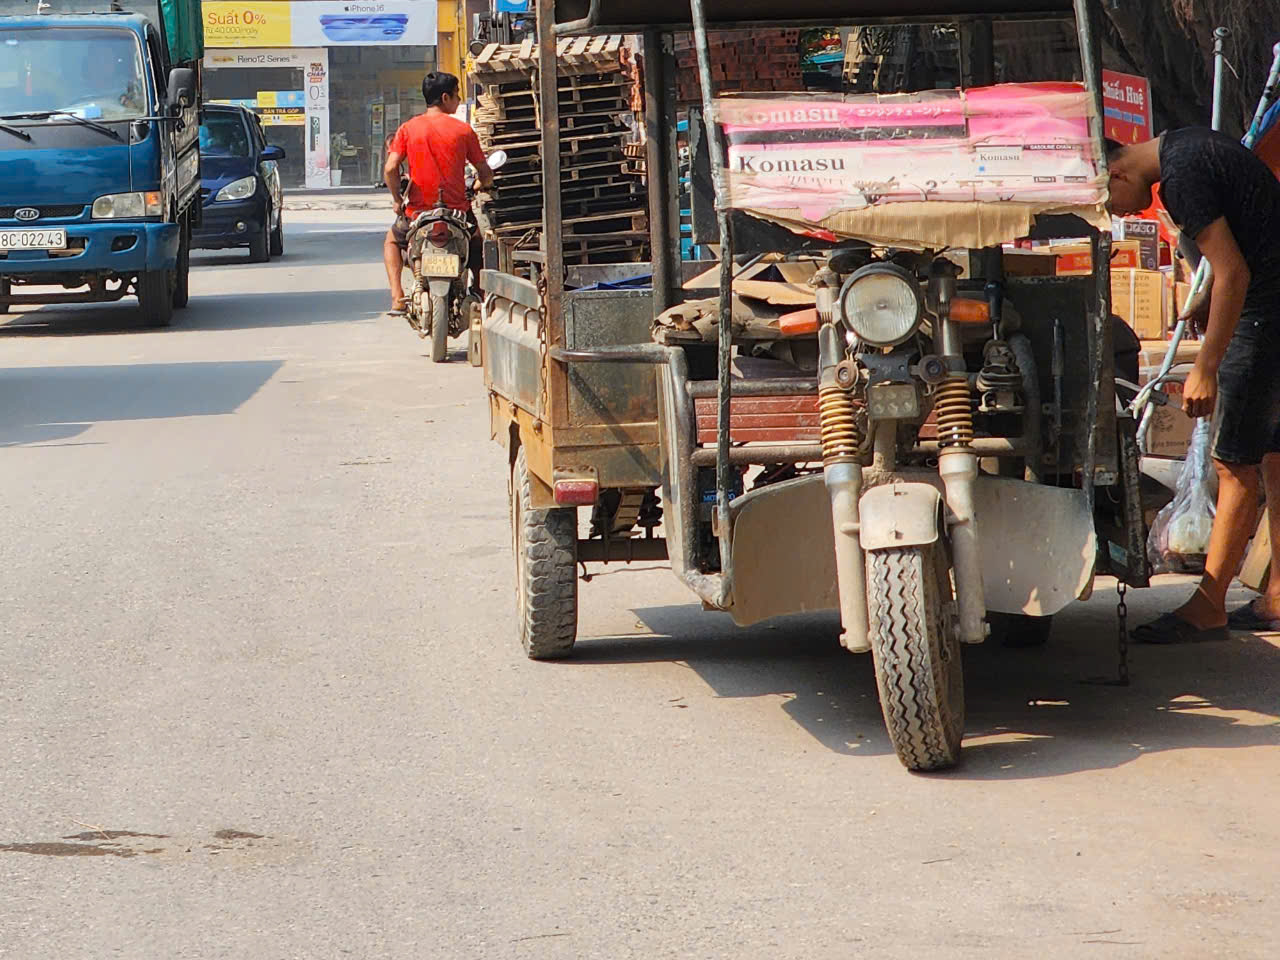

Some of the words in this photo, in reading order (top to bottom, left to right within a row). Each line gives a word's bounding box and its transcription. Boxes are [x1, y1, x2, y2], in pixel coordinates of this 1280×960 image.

[207, 9, 239, 25] Suất
[237, 55, 266, 63] Reno12
[266, 55, 290, 63] Series
[980, 153, 1020, 161] Komasu
[738, 155, 846, 173] Komasu
